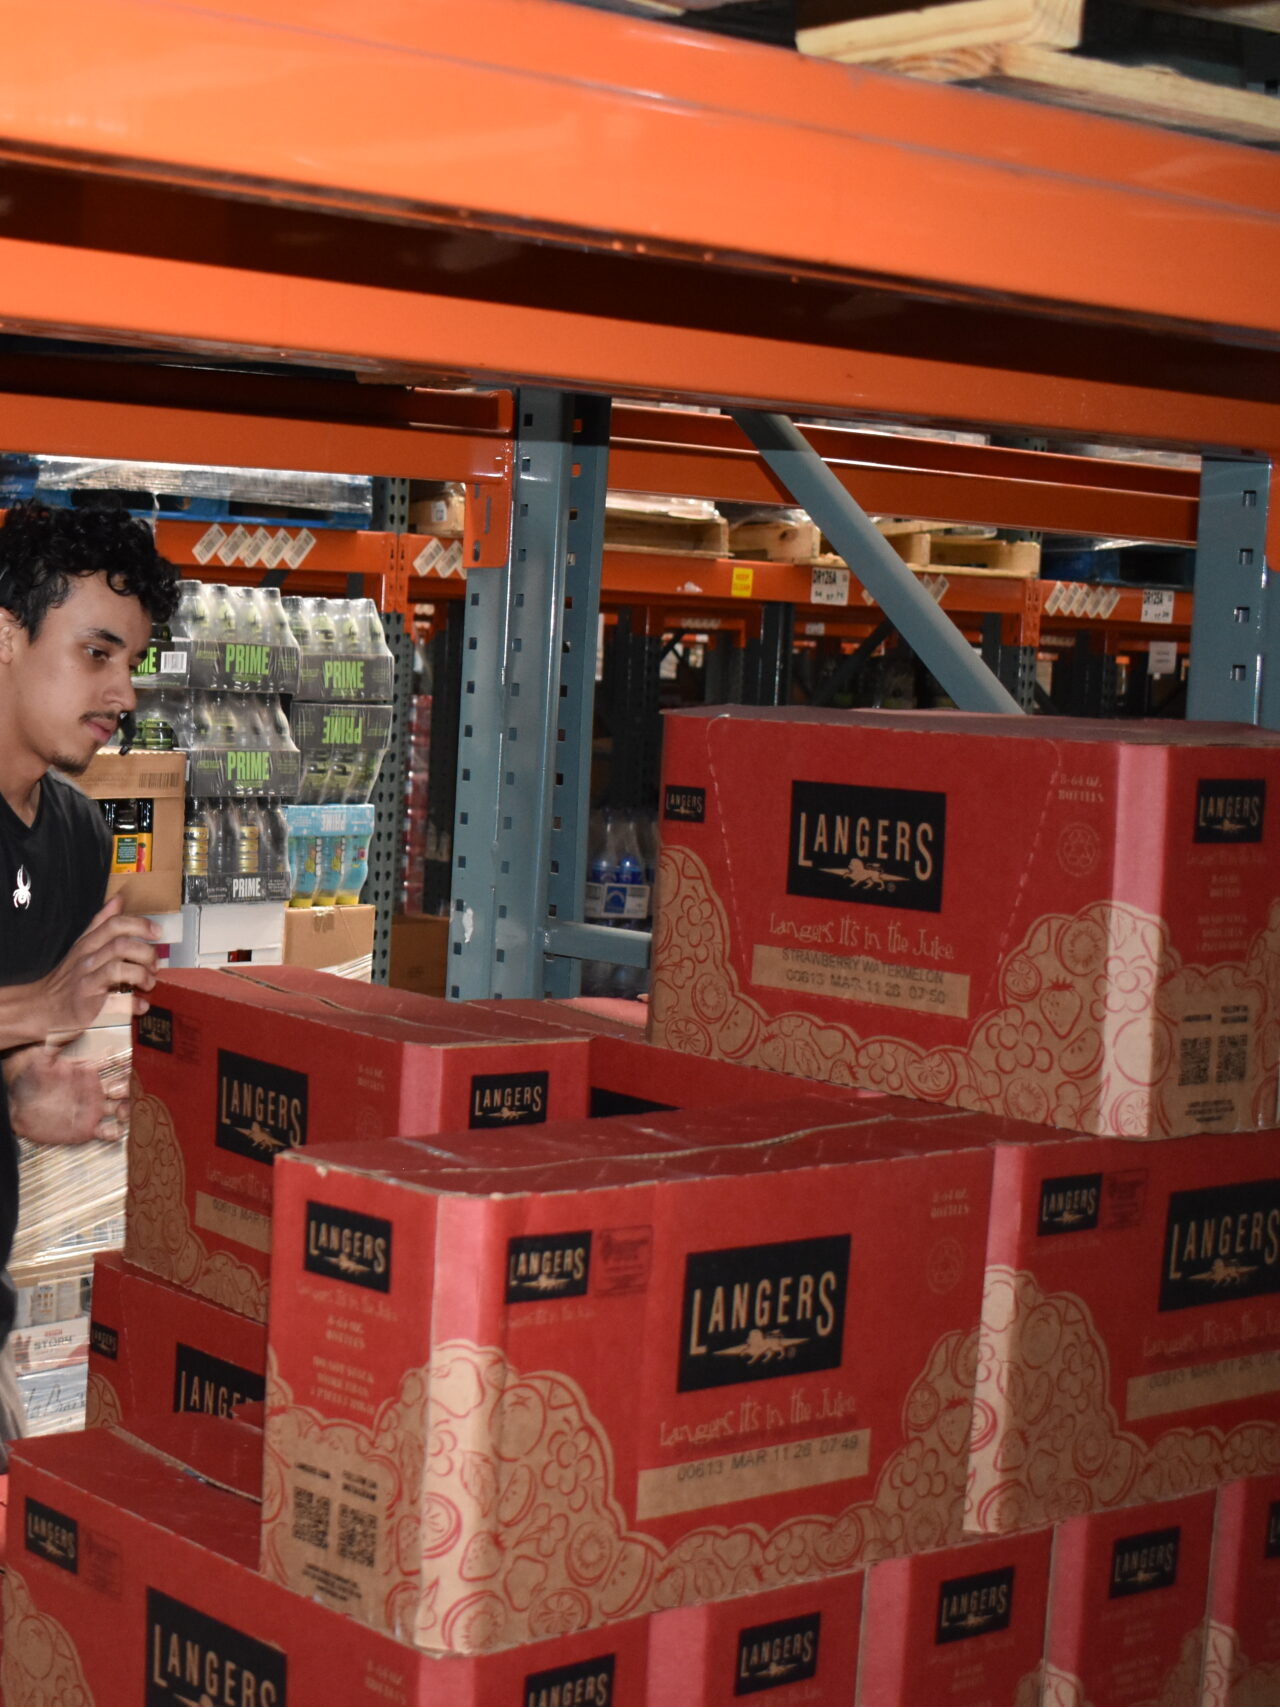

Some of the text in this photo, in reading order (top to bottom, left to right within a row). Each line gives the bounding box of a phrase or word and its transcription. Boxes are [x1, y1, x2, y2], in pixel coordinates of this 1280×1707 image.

[225, 644, 270, 675] PRIME
[324, 661, 365, 689] PRIME
[322, 716, 363, 744] PRIME
[227, 751, 270, 781] PRIME
[666, 792, 703, 813] LANGERS
[1199, 796, 1260, 826] LANGERS
[797, 812, 934, 881] LANGERS
[233, 877, 261, 898] PRIME
[782, 946, 944, 985] STRAWBERRY WATERMELON
[222, 1076, 301, 1148] LANGERS
[475, 1086, 542, 1116] LANGERS
[1043, 1187, 1096, 1221] LANGERS
[309, 1220, 386, 1275] LANGERS
[1170, 1209, 1280, 1280] LANGERS
[510, 1247, 584, 1286] LANGERS
[690, 1271, 836, 1356] LANGERS
[180, 1371, 254, 1418] LANG
[731, 1451, 767, 1470] MAR
[28, 1512, 75, 1559] LANGERS
[941, 1584, 1007, 1627] LANGERS
[741, 1630, 814, 1677] LANGERS
